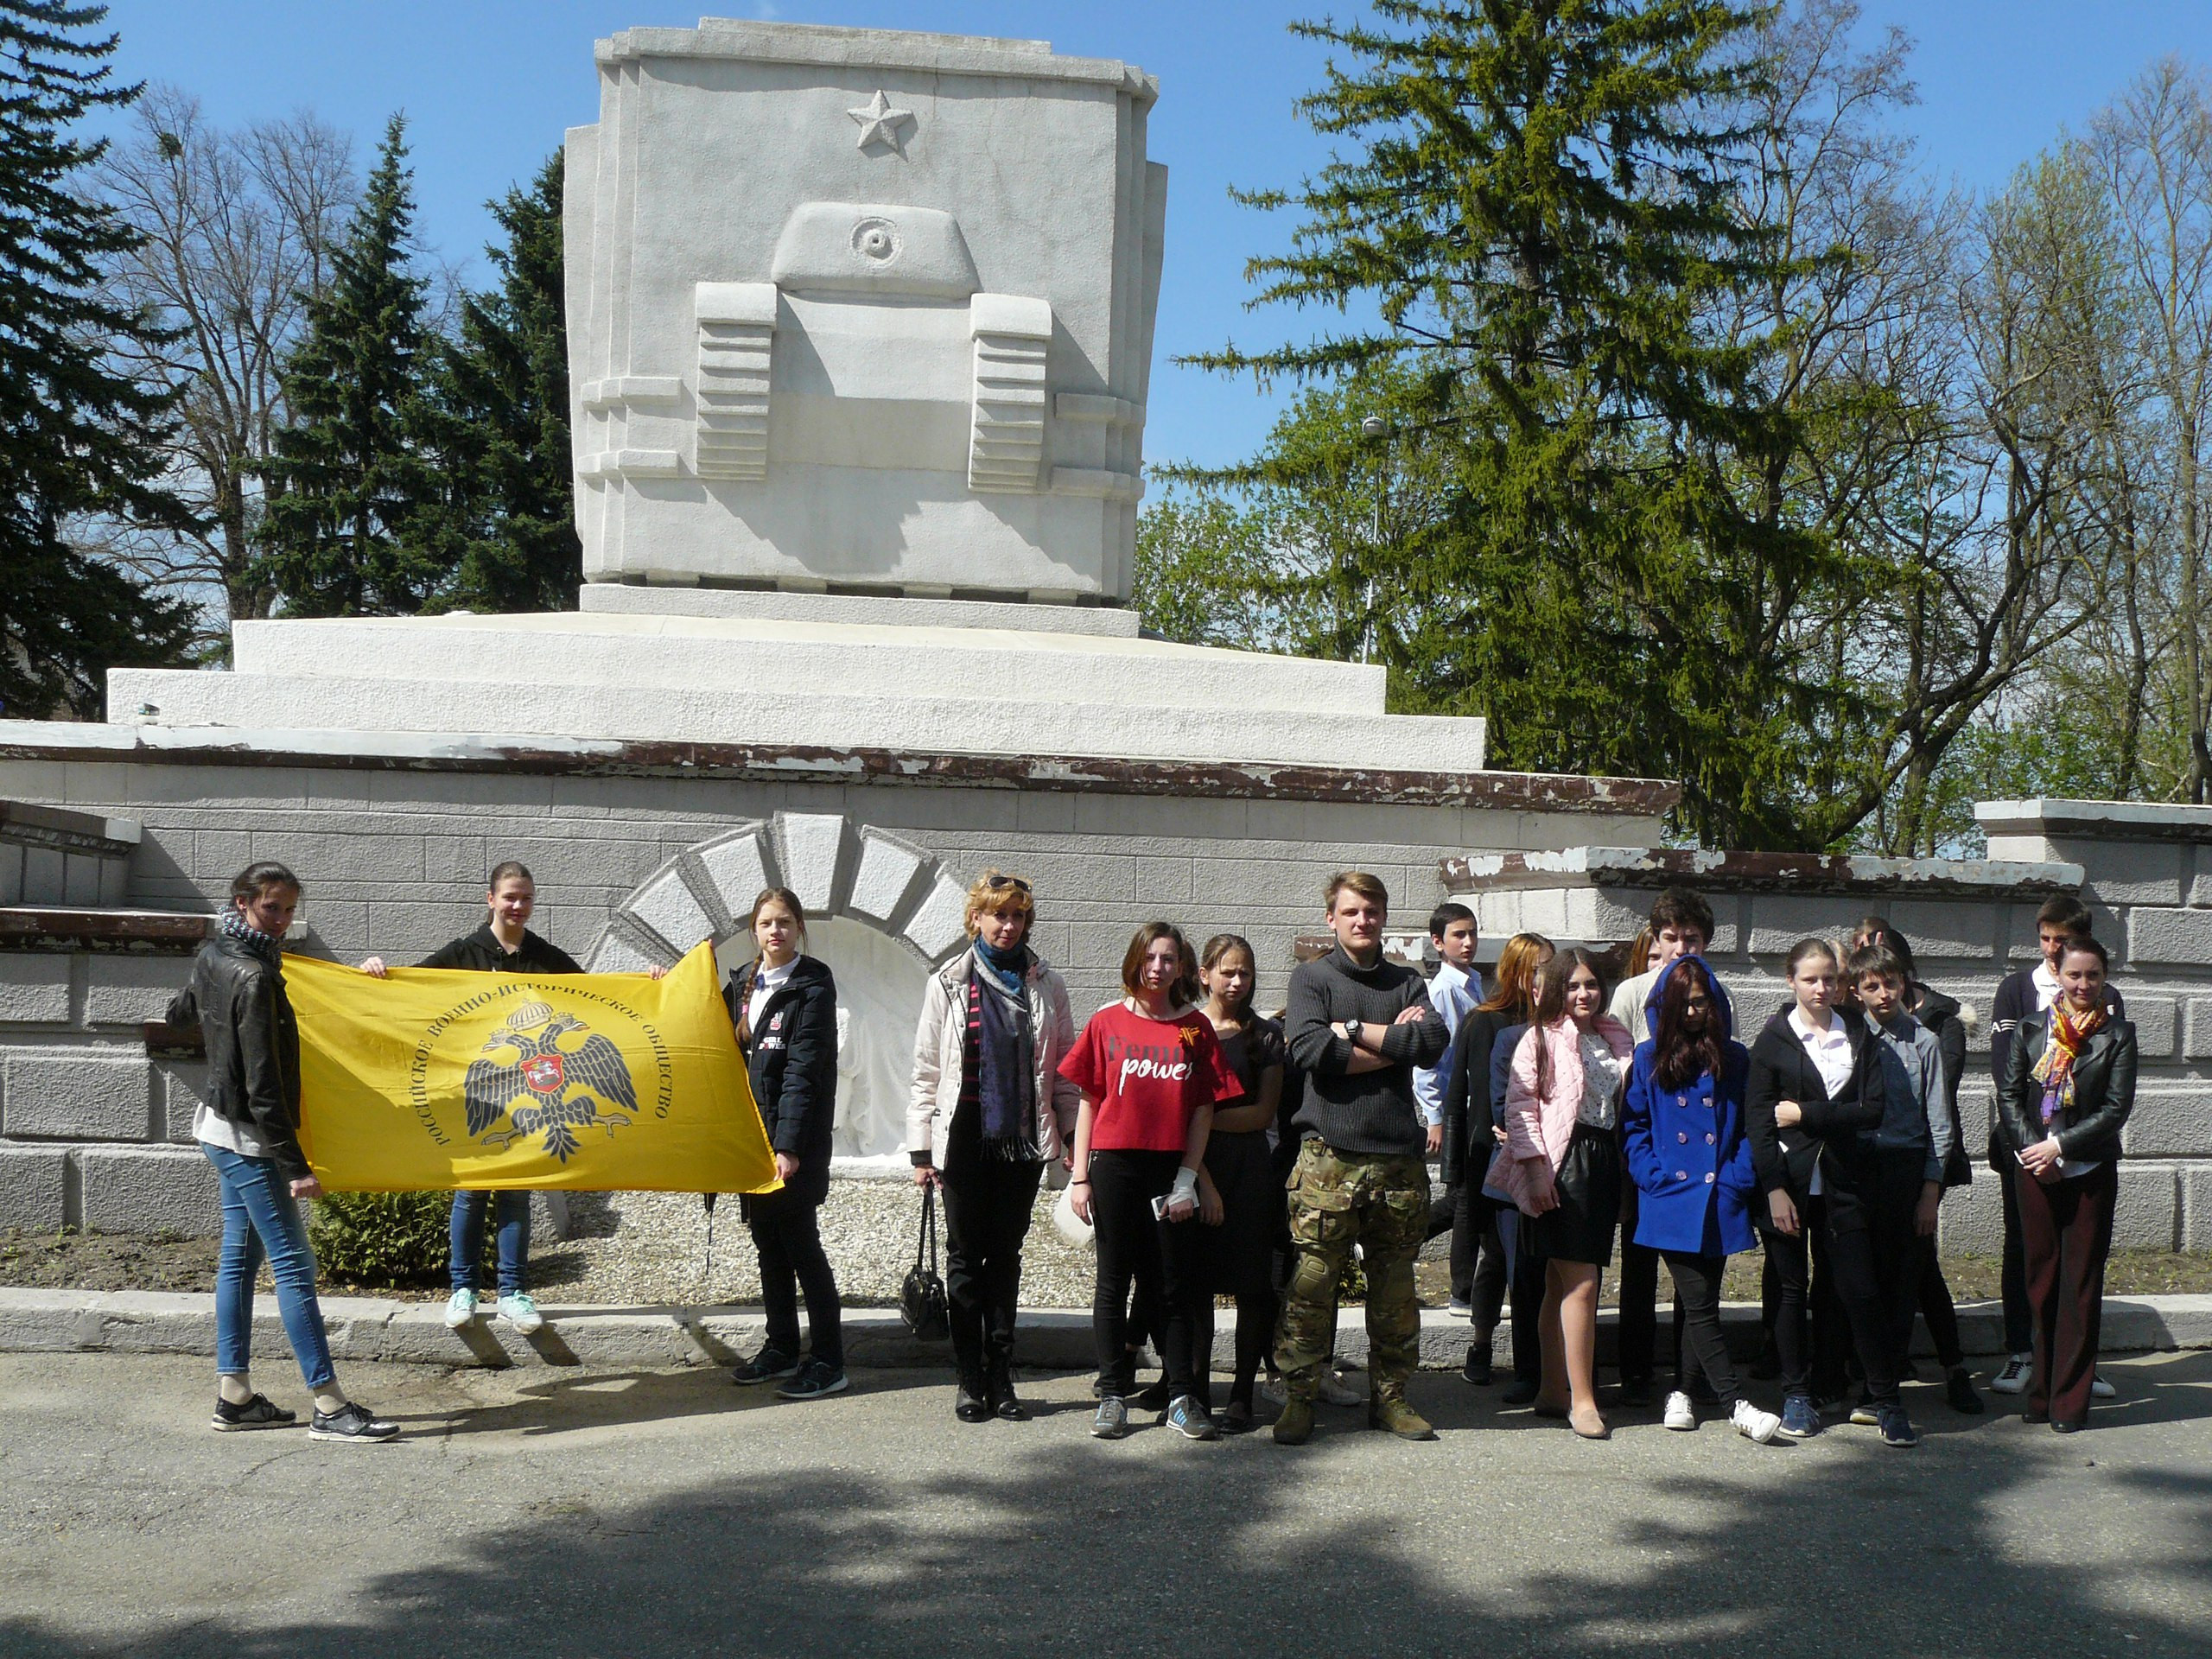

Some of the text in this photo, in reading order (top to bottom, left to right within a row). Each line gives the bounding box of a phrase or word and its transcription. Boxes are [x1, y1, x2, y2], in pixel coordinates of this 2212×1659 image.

[409, 982, 673, 1147] РОССИЙСКОЕ ВОЕННО-ИСТОРИЧЕСКОЕ ОБЩЕСТВО
[1118, 1058, 1193, 1096] power
